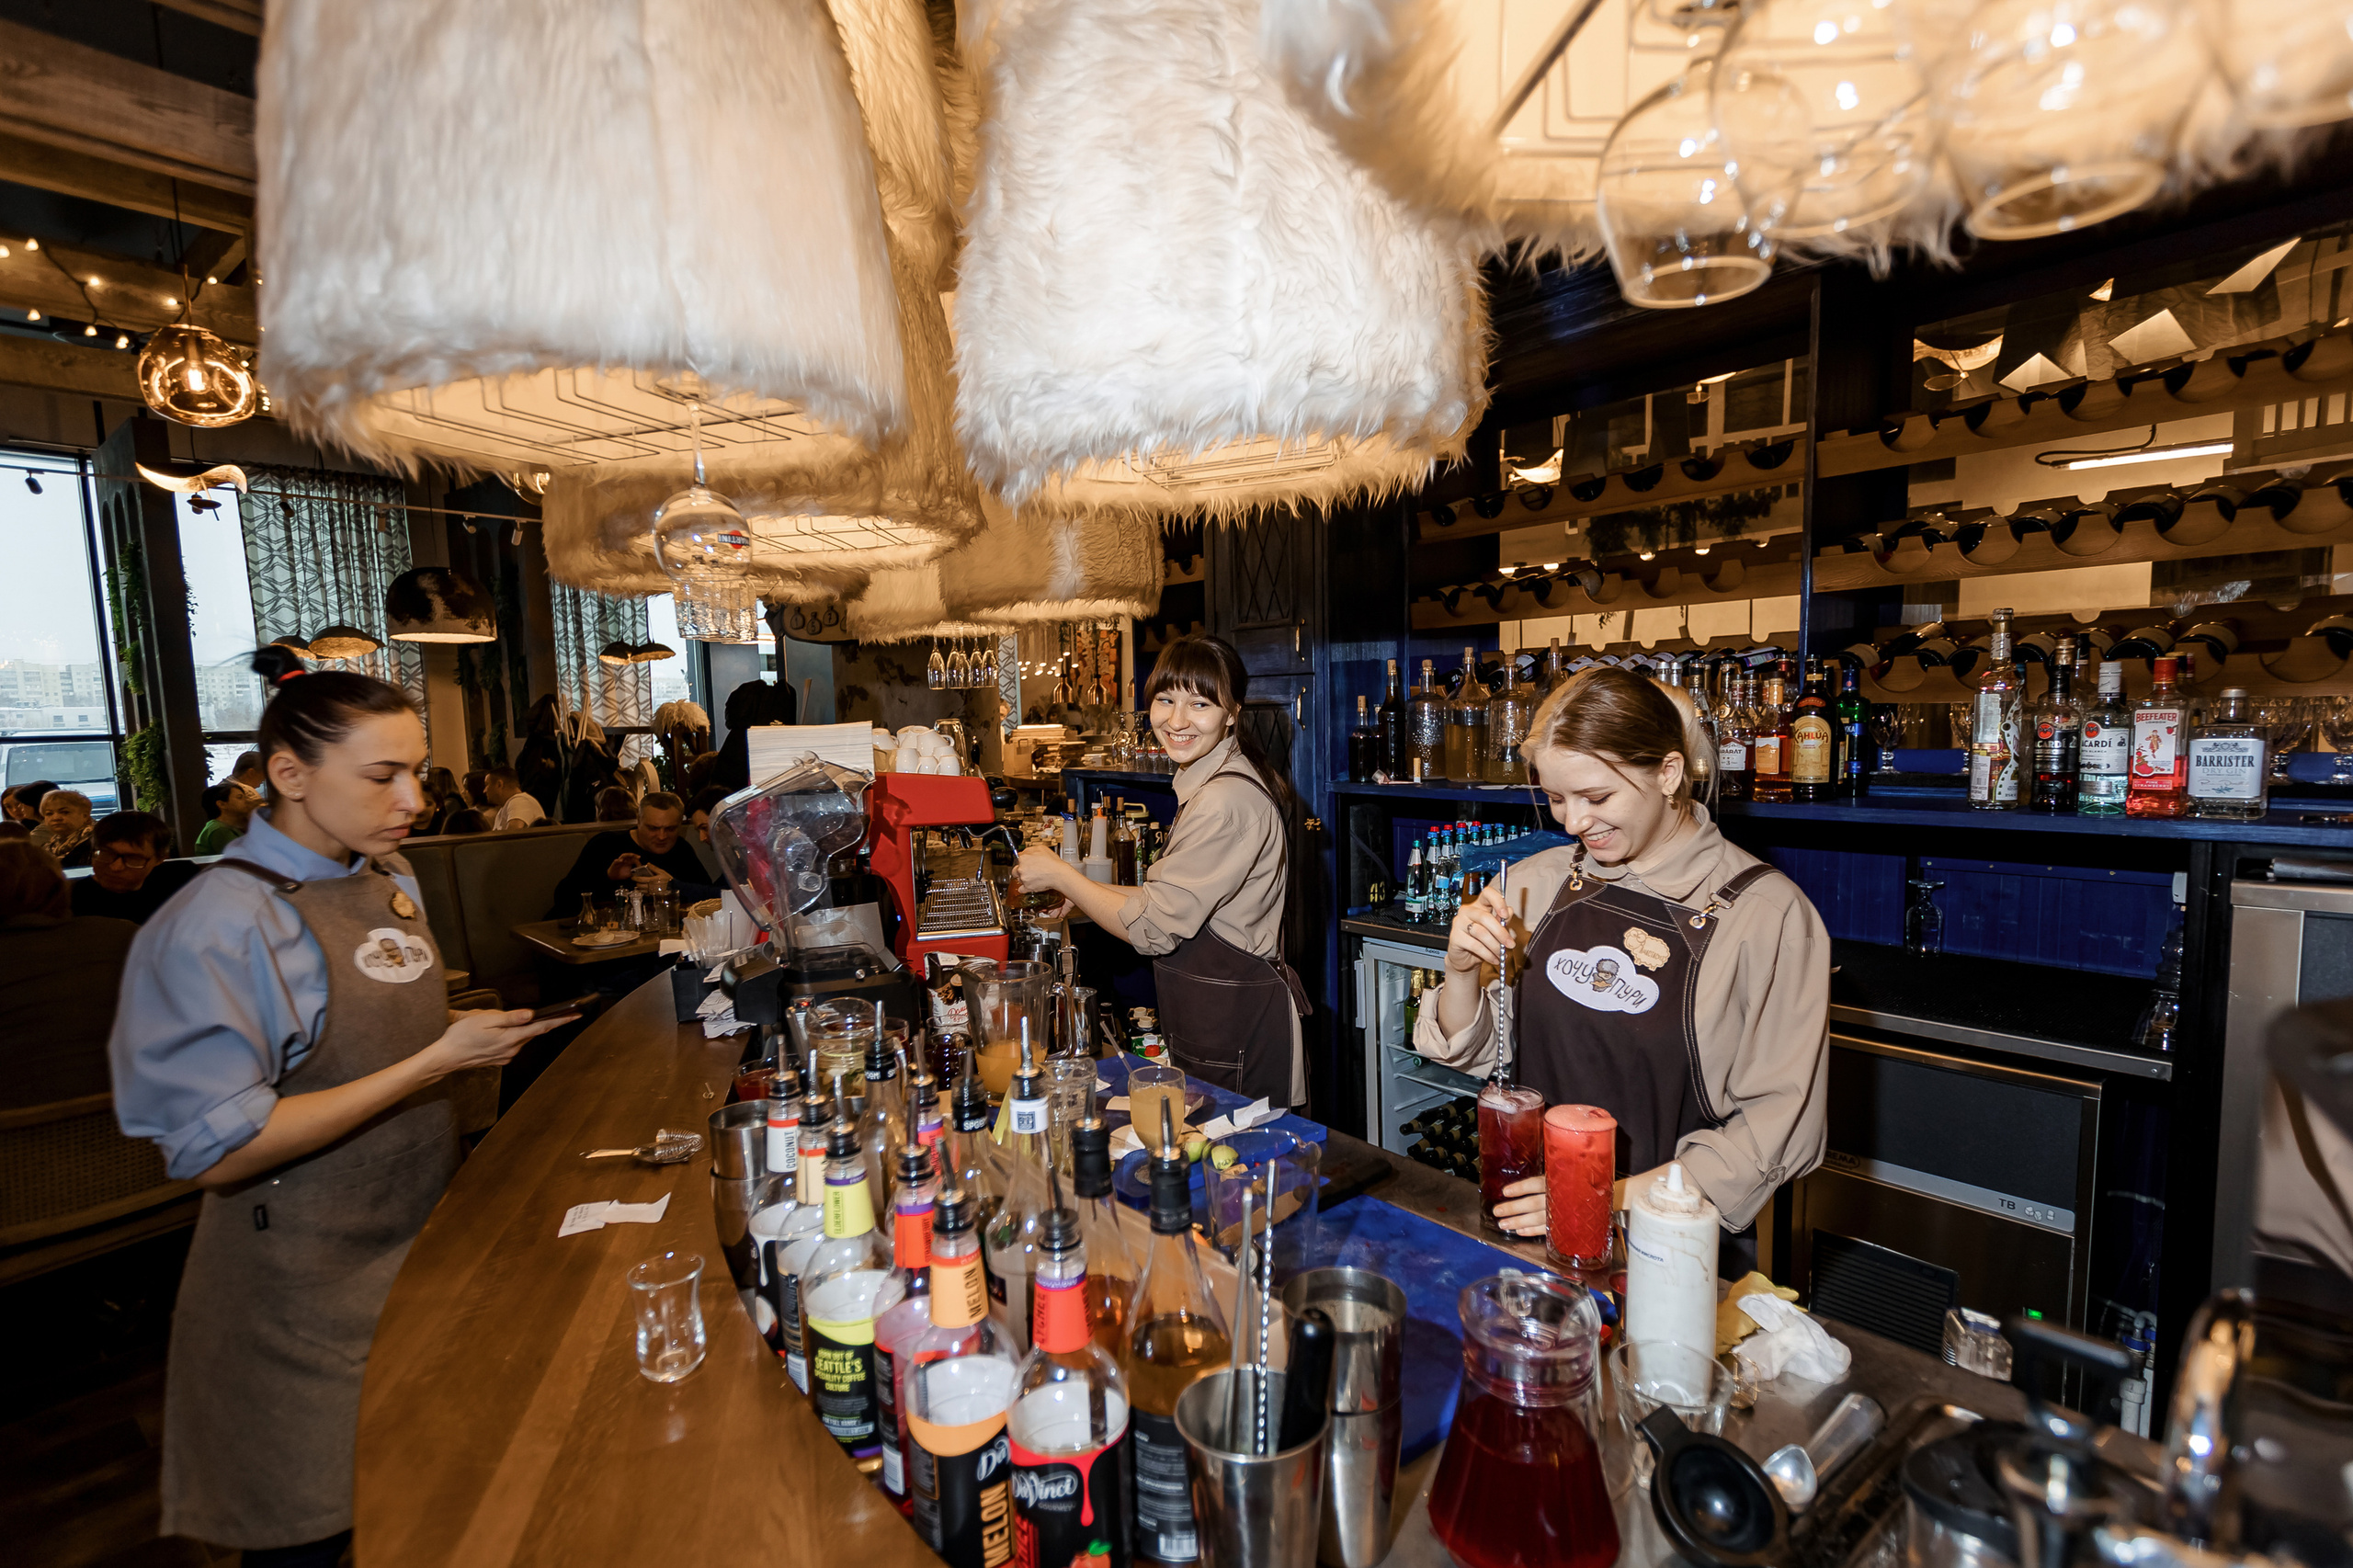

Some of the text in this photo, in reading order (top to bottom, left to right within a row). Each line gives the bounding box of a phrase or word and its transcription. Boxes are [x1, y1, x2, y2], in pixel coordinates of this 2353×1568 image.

[2135, 712, 2177, 722] BEEFEATER
[1794, 729, 1829, 744] KAHLÚA
[2195, 756, 2255, 767] BARRISTER
[1554, 958, 1648, 1008] ХОЧУ ПУРИ
[784, 1131, 796, 1169] COCONUT
[1825, 1151, 1857, 1165] REMA
[833, 1191, 842, 1234] ELDERFLOWER
[1998, 1198, 2016, 1210] TB
[964, 1267, 983, 1319] MELON
[1036, 1293, 1046, 1344] LYCHEE
[814, 1357, 863, 1374] SEATTLE'S
[842, 1369, 866, 1383] COFFEE
[980, 1480, 1010, 1568] MELON
